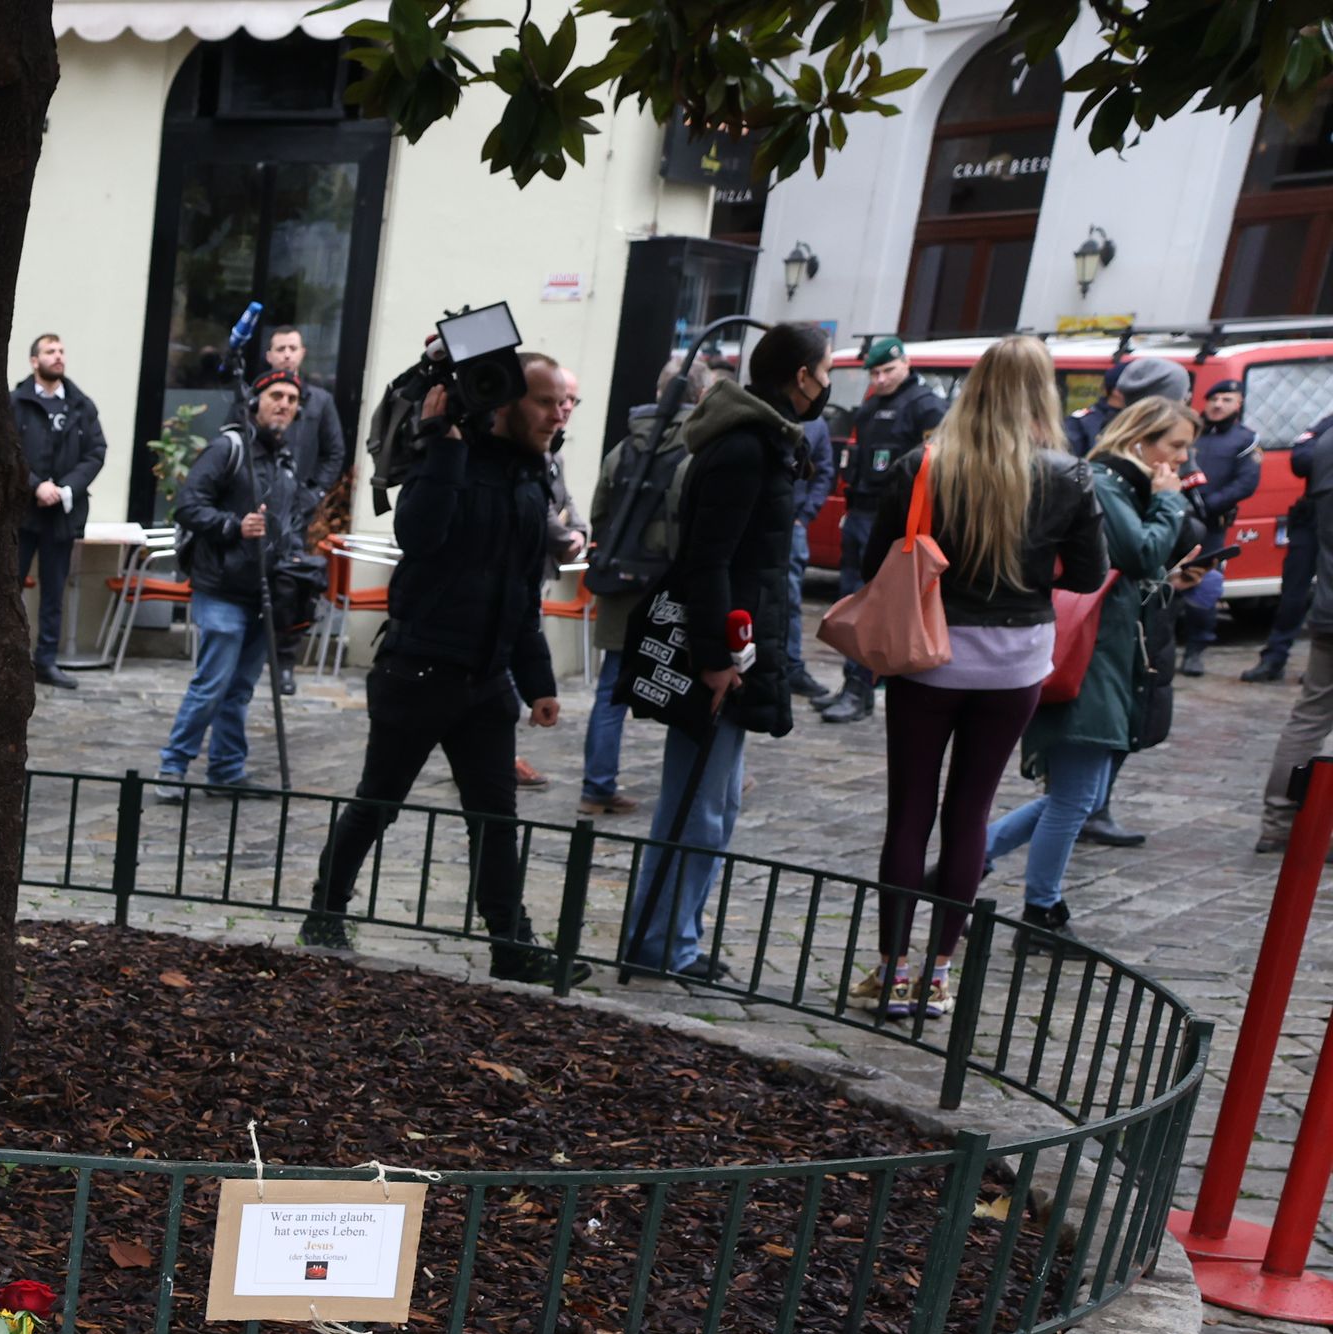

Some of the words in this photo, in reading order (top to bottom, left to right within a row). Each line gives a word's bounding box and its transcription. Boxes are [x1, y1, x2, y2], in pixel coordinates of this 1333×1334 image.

[953, 160, 1004, 179] CRAFT
[1010, 156, 1051, 175] BEER
[636, 682, 666, 701] FROM
[271, 1211, 293, 1222] Wer
[295, 1213, 308, 1222] an
[311, 1211, 337, 1222] mich
[339, 1212, 376, 1224] glaubt,
[274, 1226, 290, 1236] hat
[293, 1226, 329, 1238] ewiges
[332, 1226, 368, 1237] Leben.
[304, 1241, 334, 1251] Jesus
[289, 1253, 303, 1261] (der
[304, 1253, 321, 1261] Sohn
[322, 1253, 348, 1261] Gottes)
